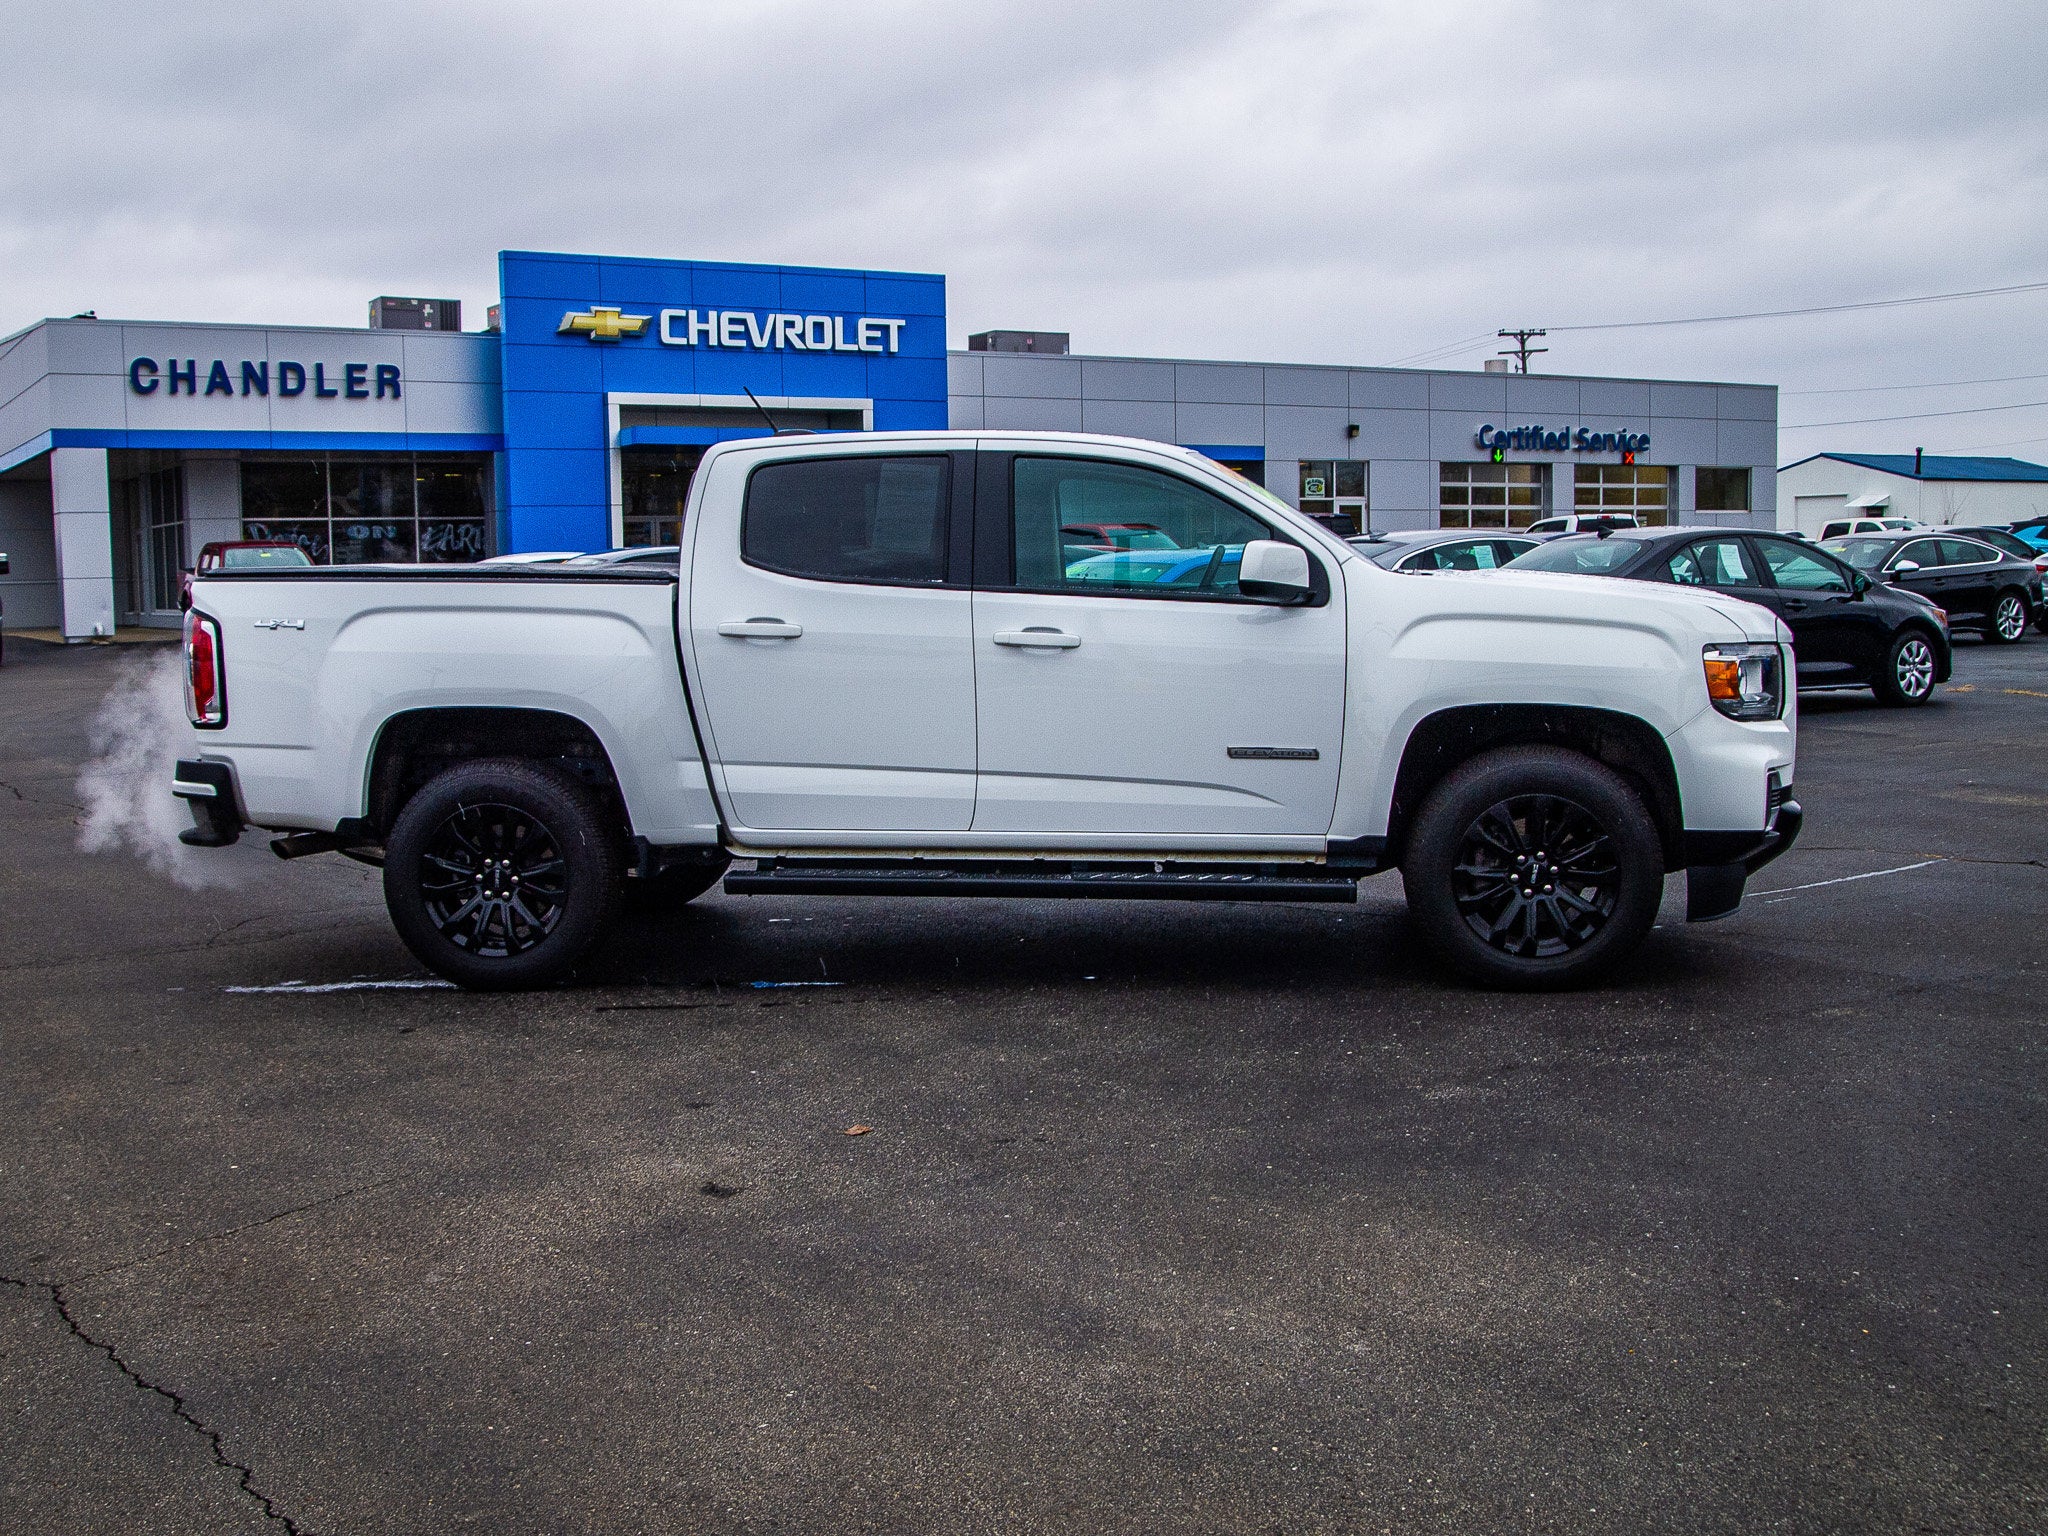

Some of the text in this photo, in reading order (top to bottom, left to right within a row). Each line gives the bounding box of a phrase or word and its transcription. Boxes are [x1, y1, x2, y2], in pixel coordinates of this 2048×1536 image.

[660, 308, 906, 353] CHEVROLET
[129, 356, 401, 399] CHANDLER
[1478, 424, 1650, 451] Certified Service
